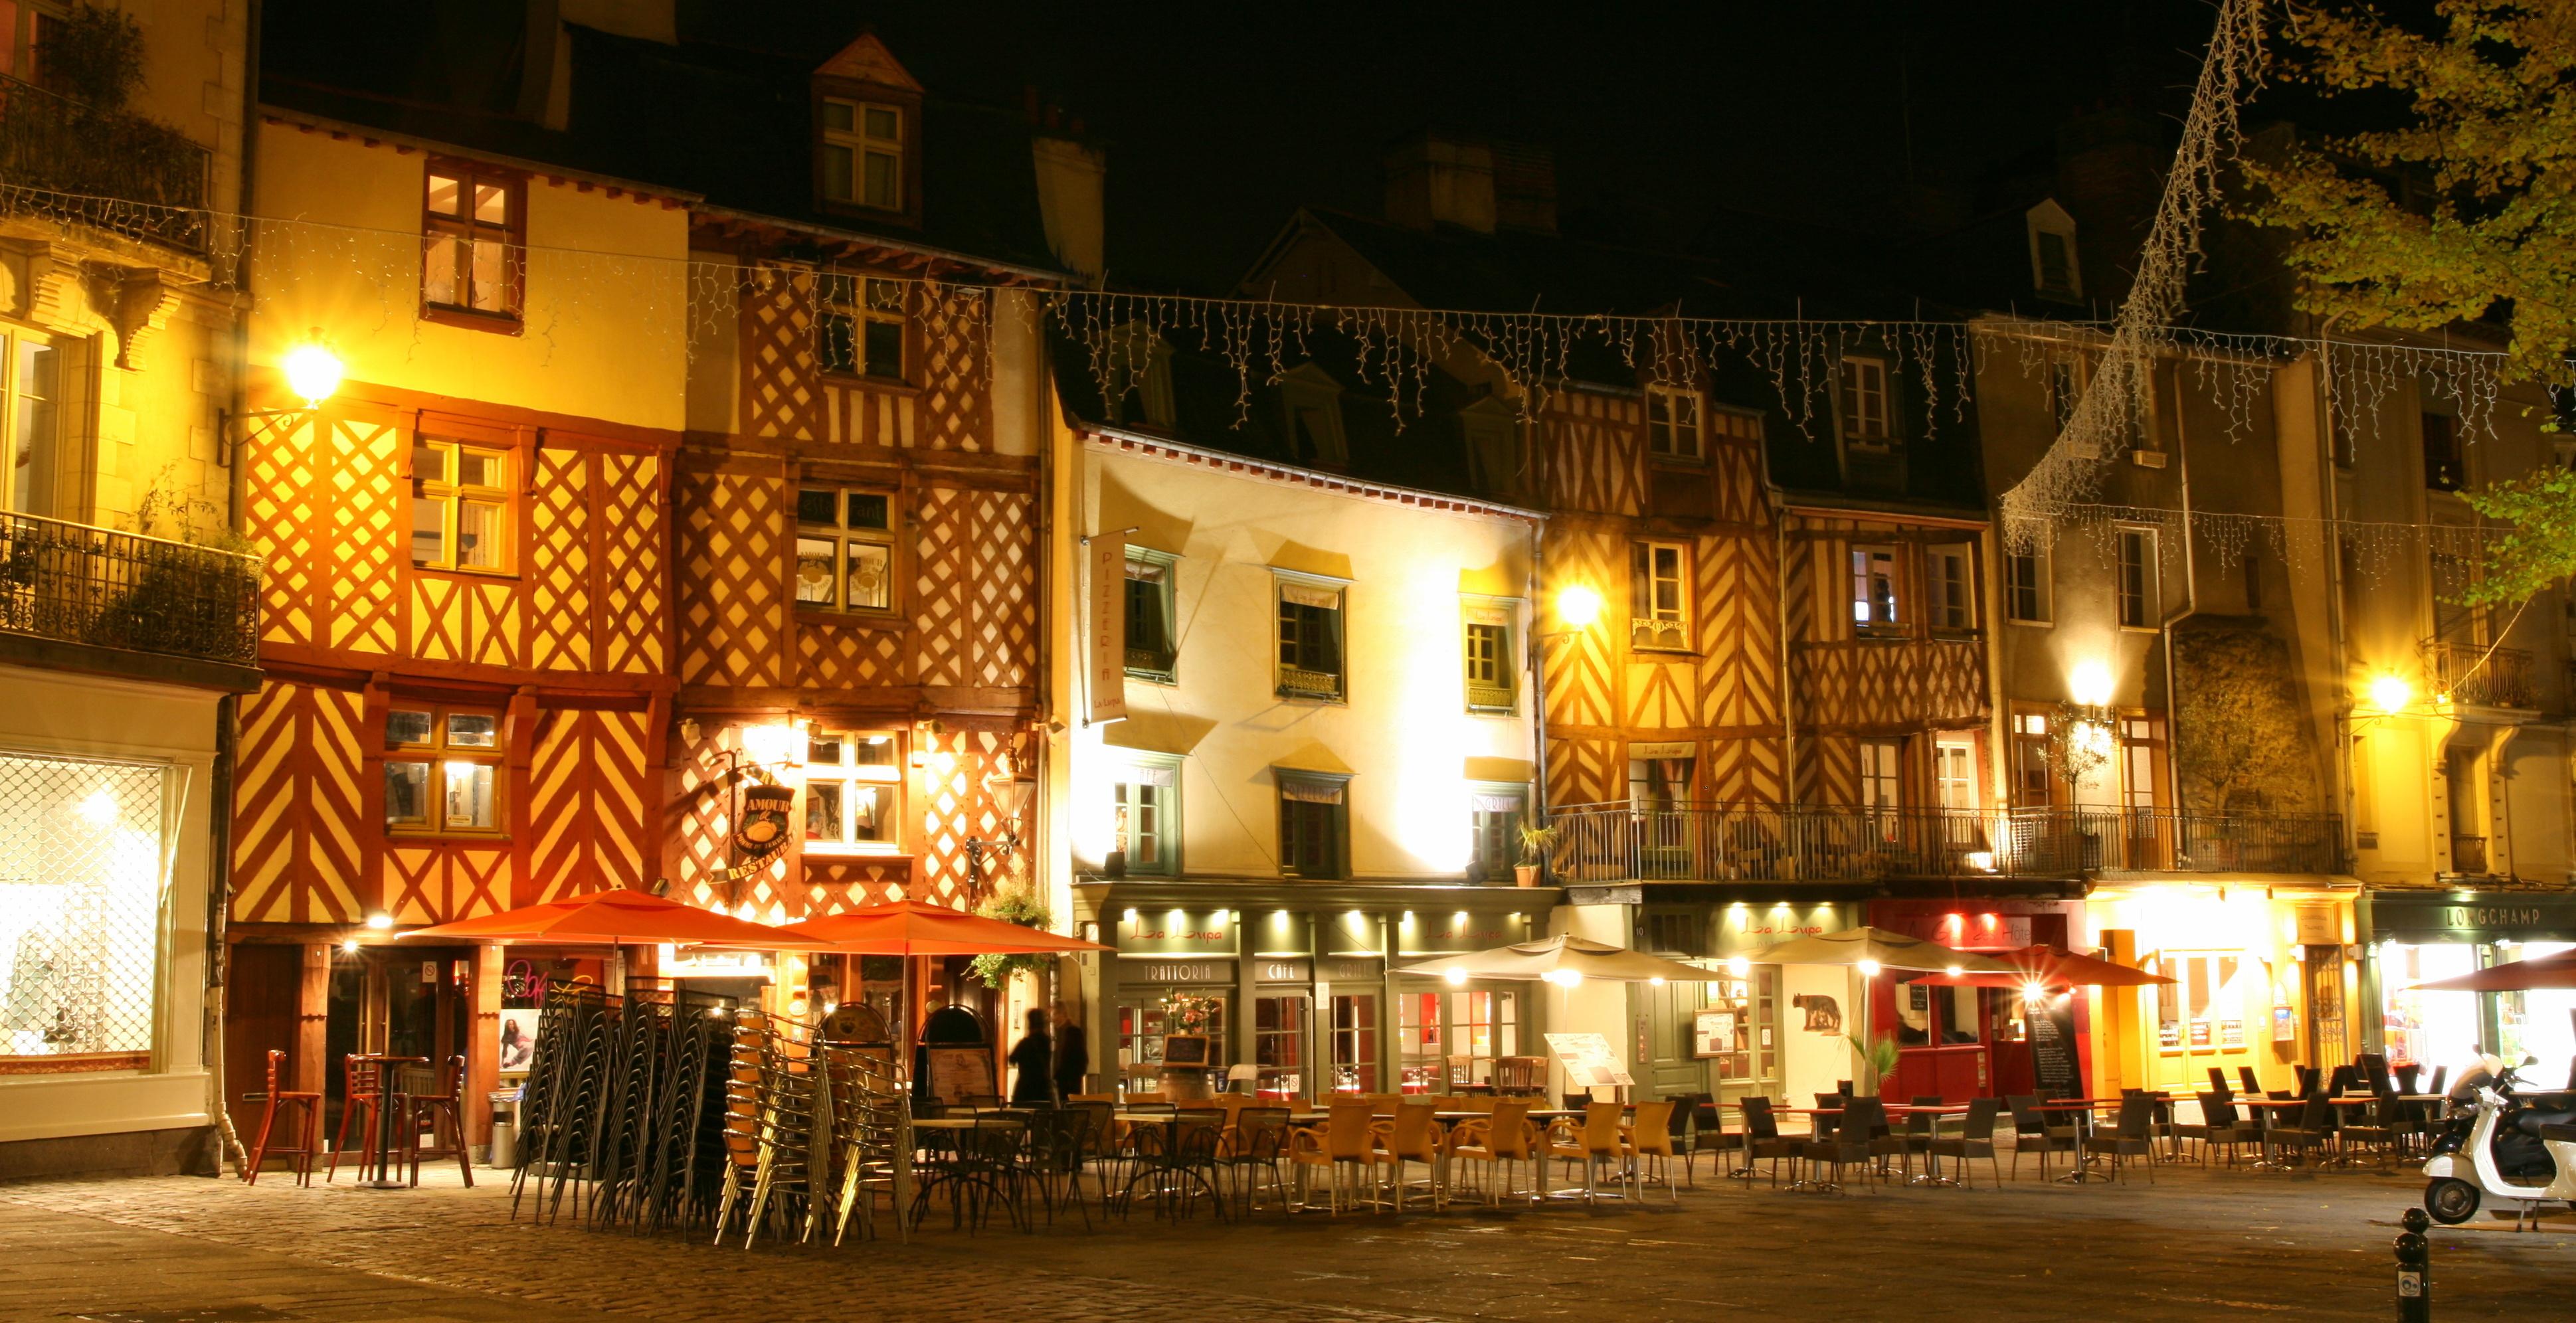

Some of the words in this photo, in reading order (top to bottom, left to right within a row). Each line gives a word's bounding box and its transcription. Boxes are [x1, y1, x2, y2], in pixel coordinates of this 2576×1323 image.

[1099, 551, 1113, 681] PIZZERIA
[1139, 768, 1158, 784] AFE
[747, 798, 790, 811] AMOUR
[2446, 908, 2539, 926] LONGCHAMP
[1131, 919, 1165, 940] La
[1170, 920, 1222, 944] Lupa
[1424, 920, 1453, 939] La
[1635, 926, 1644, 936] 10
[1741, 916, 1772, 935] La
[1777, 916, 1823, 938] Lupa
[1145, 964, 1211, 981] TRATTORIA
[1339, 964, 1368, 978] GRILL
